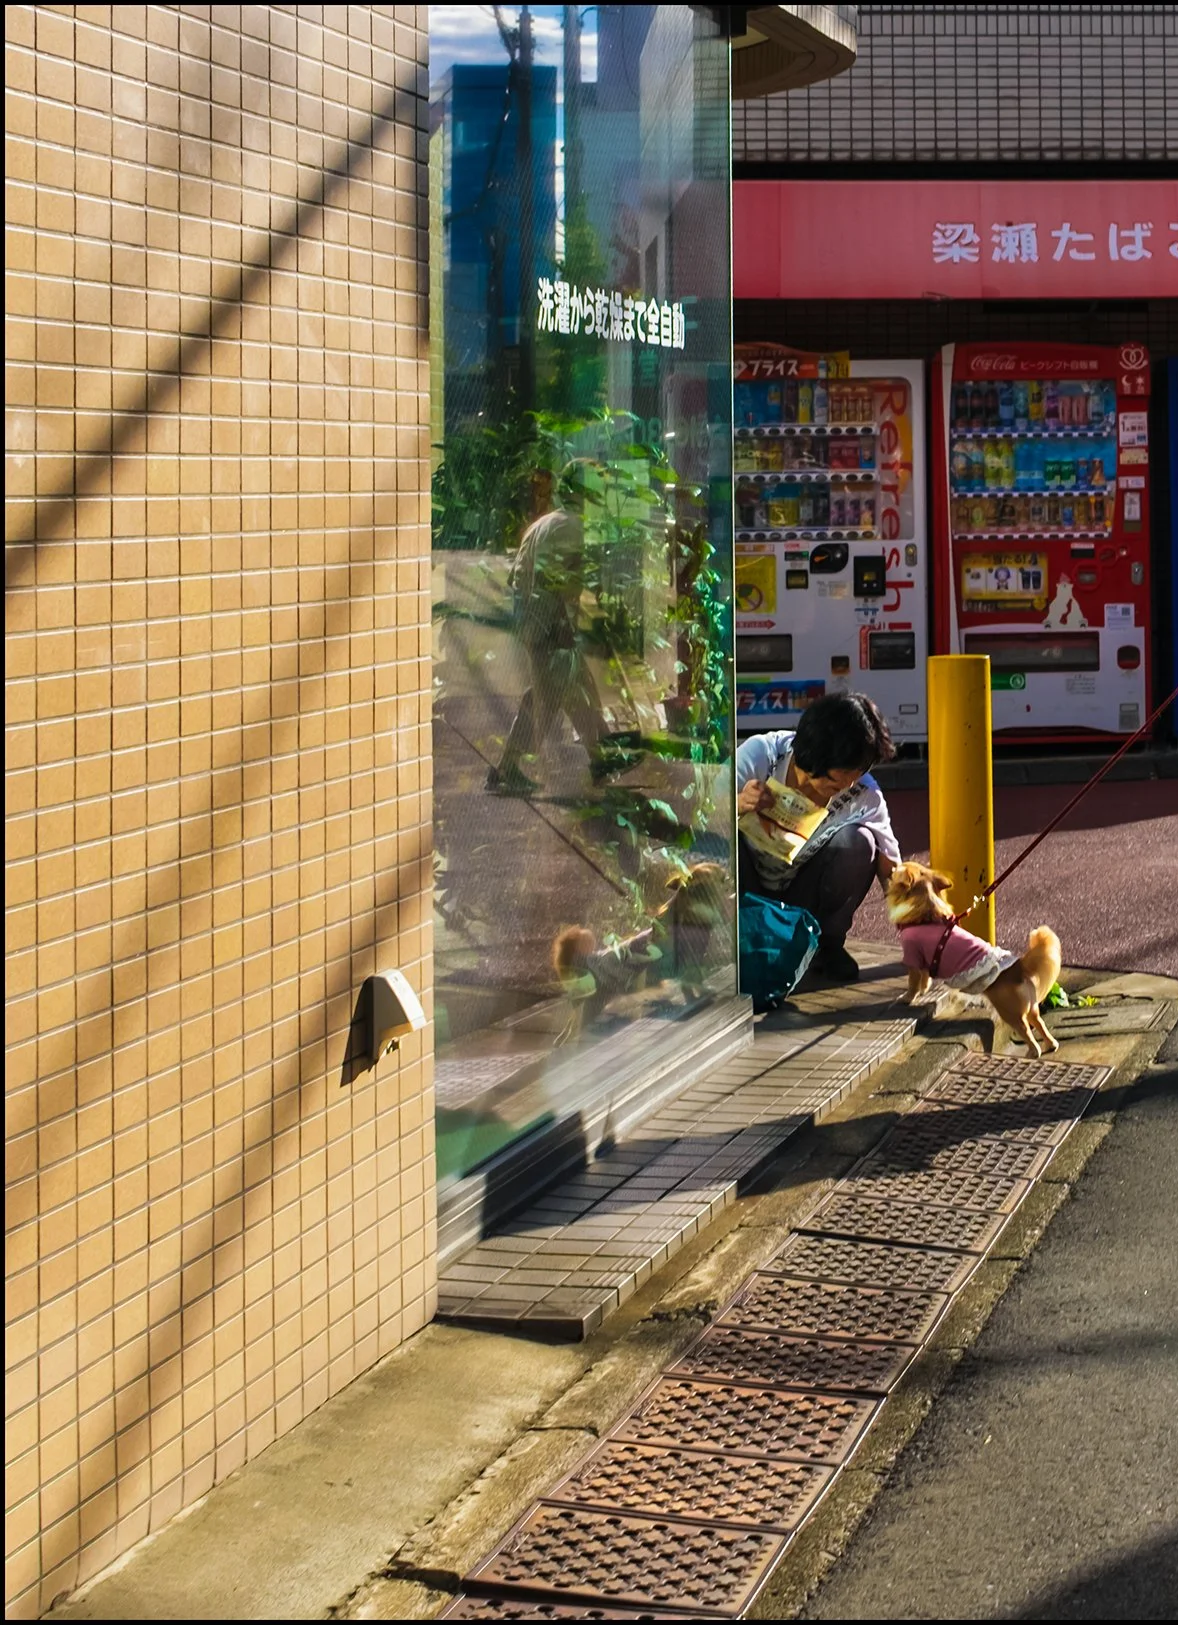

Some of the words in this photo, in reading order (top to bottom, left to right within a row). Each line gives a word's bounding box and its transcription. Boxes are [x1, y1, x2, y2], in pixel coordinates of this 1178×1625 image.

[537, 276, 685, 350] 洗濯から乾燥まで全自動
